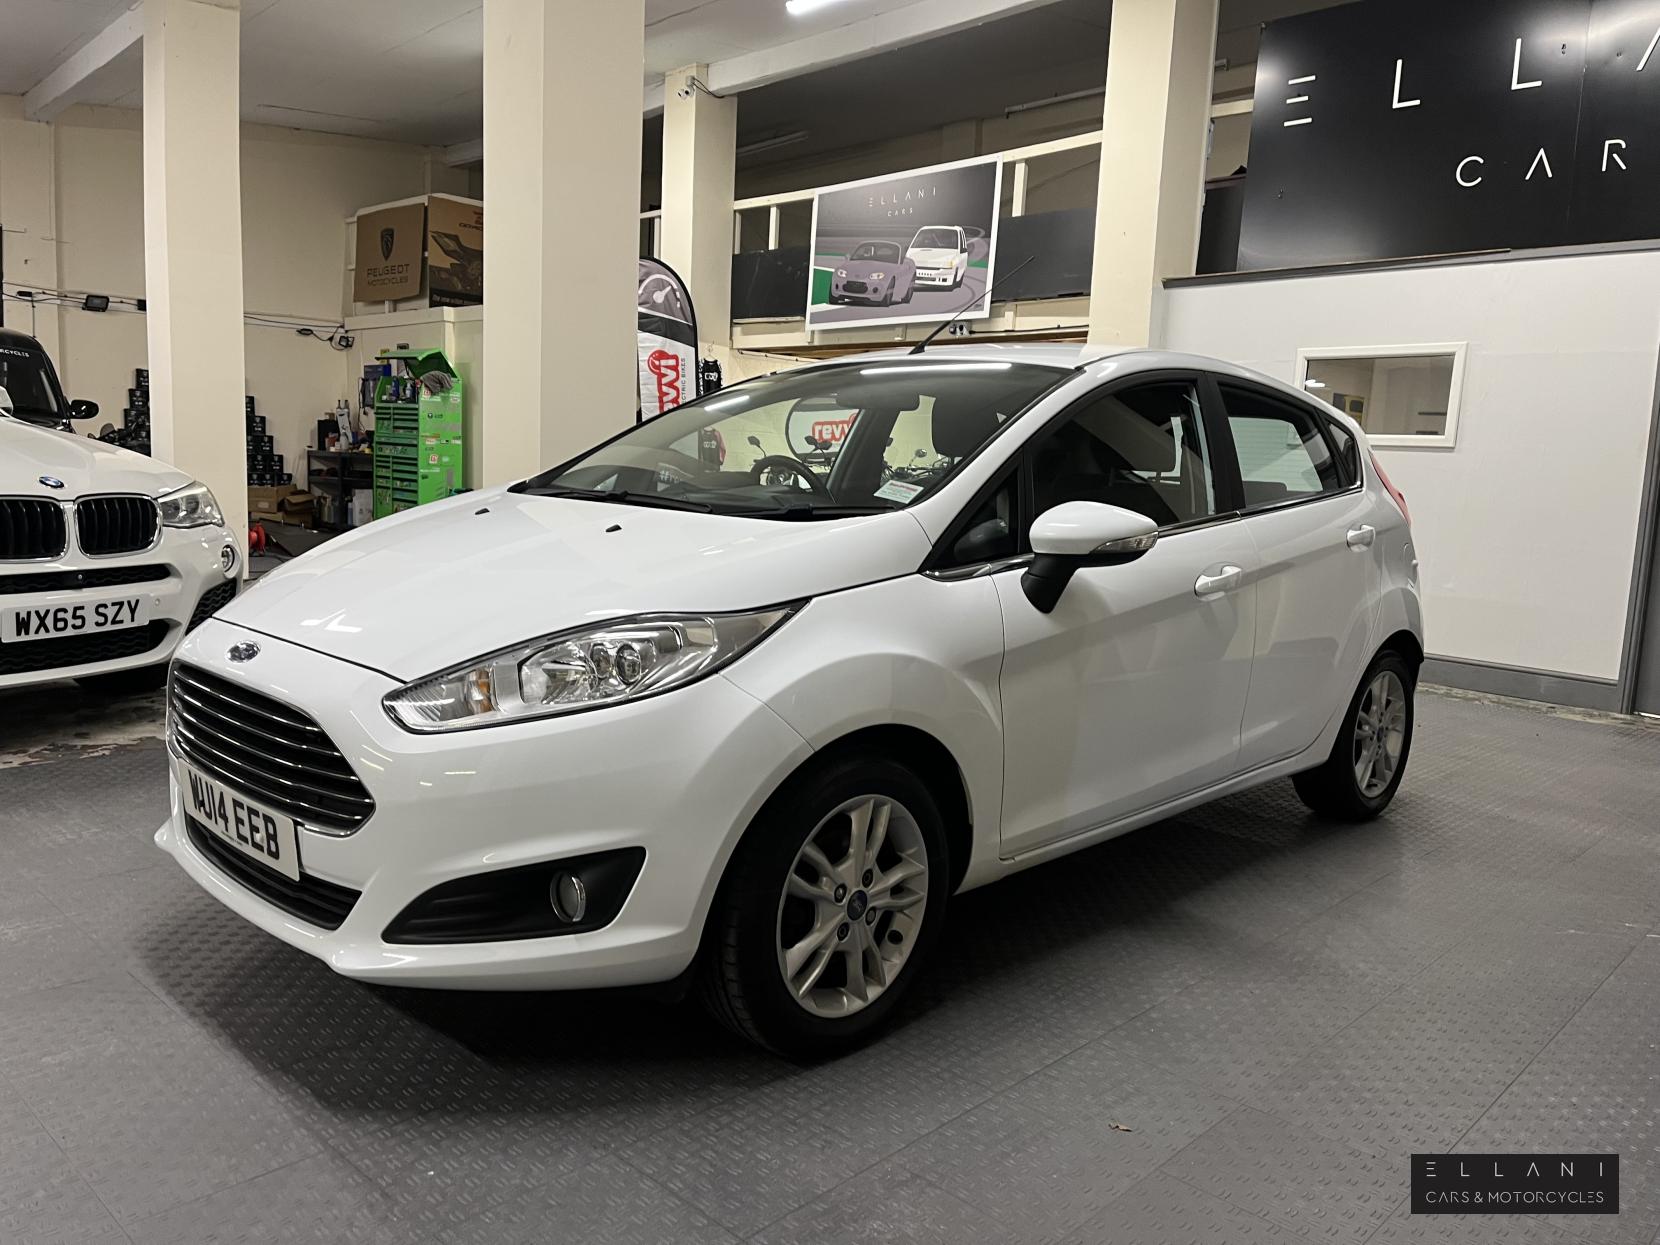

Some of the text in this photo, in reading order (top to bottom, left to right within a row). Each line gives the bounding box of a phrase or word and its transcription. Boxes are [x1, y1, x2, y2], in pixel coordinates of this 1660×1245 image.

[868, 186, 937, 207] ELLANI
[887, 207, 913, 217] CARS
[367, 263, 410, 278] PEUGEOT
[15, 598, 140, 637] WX65 SZY
[188, 768, 280, 860] WU14 EEB
